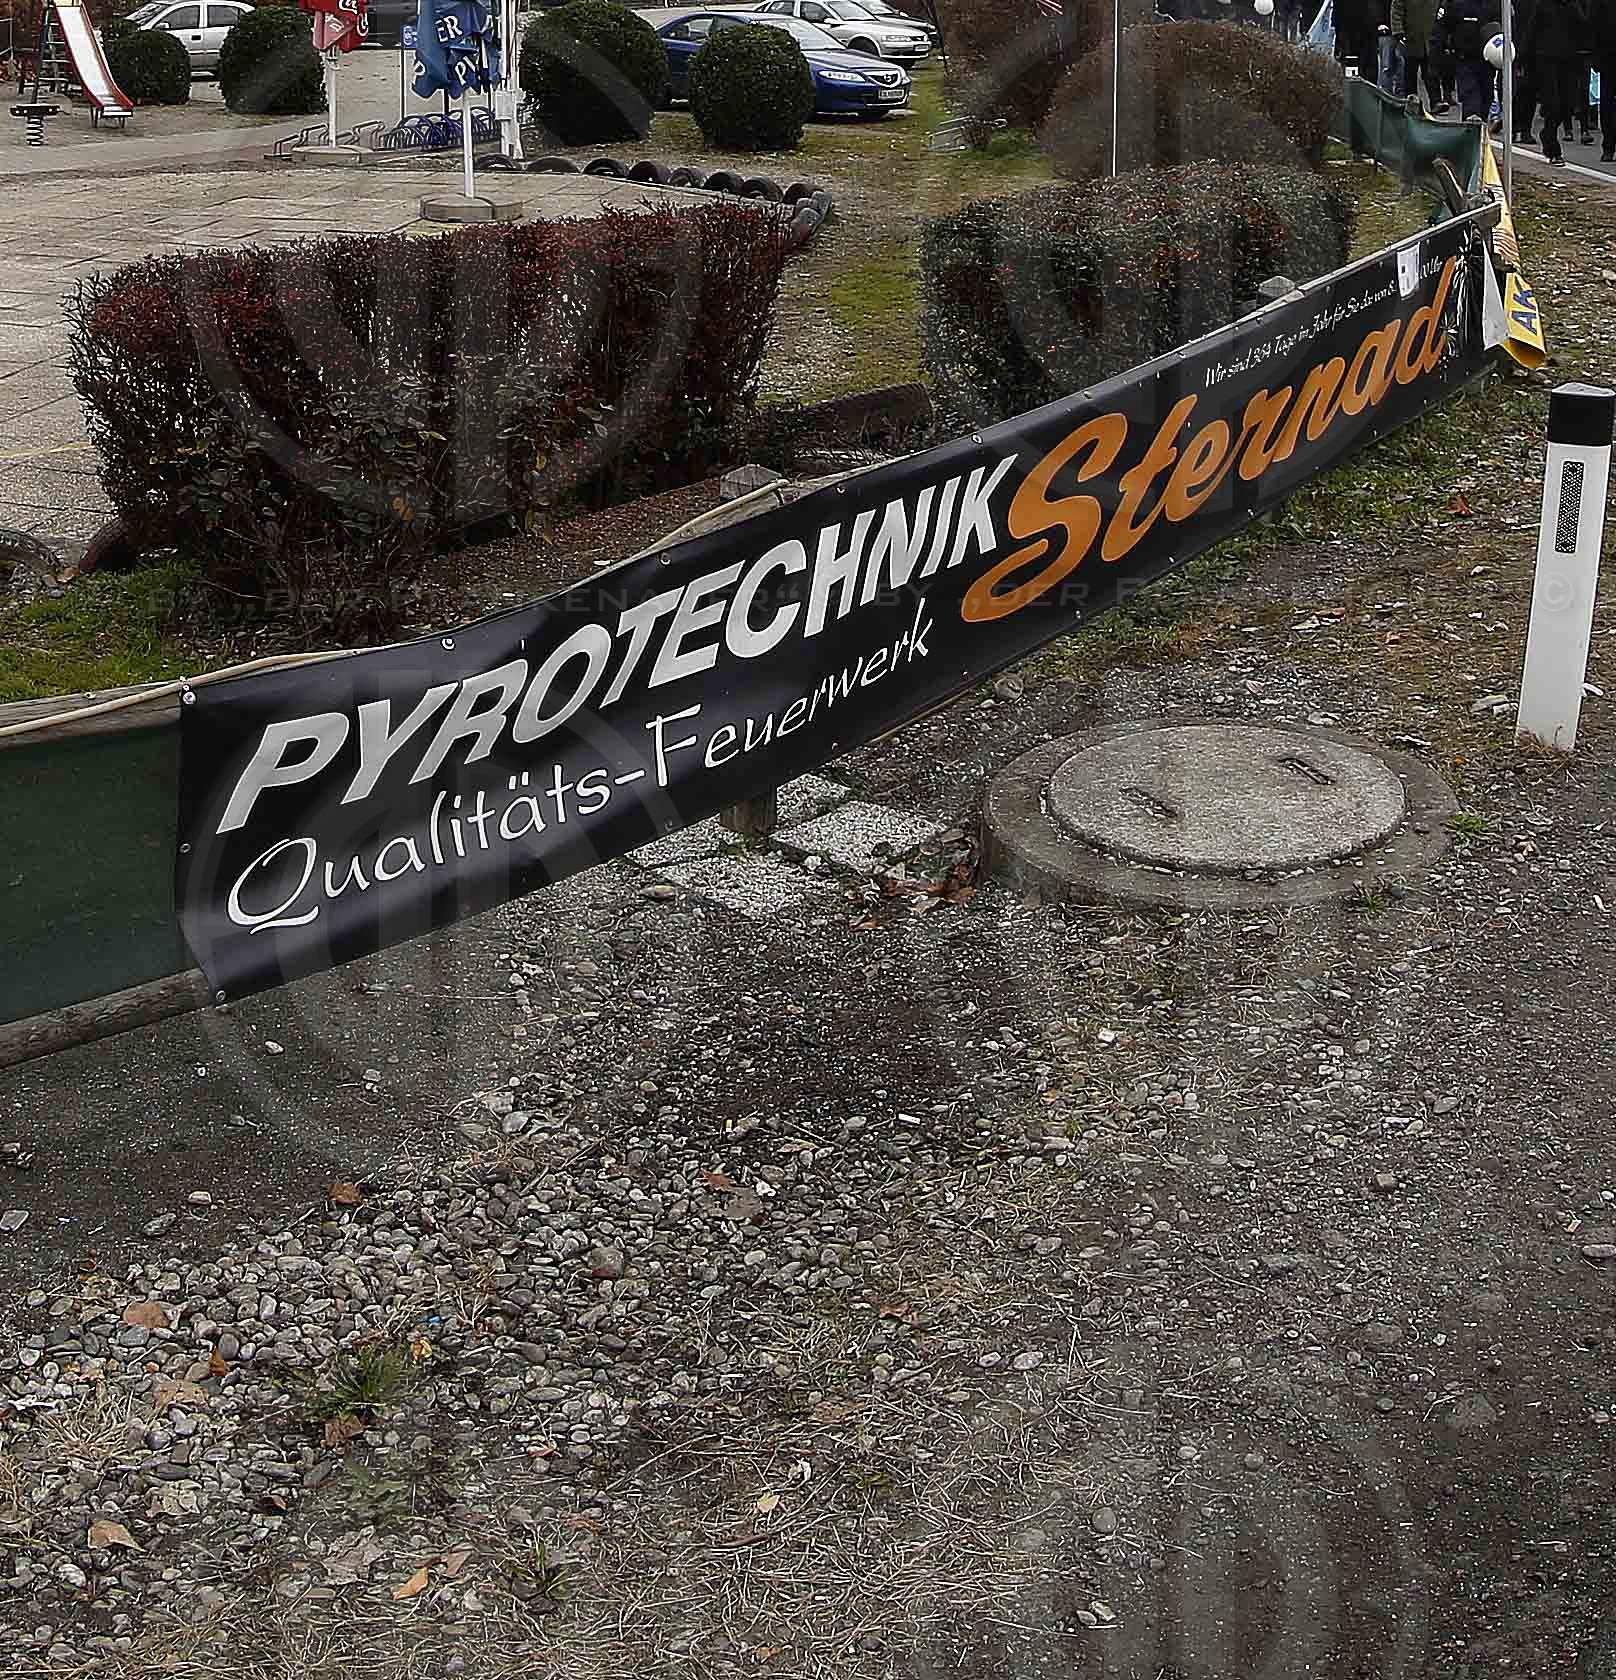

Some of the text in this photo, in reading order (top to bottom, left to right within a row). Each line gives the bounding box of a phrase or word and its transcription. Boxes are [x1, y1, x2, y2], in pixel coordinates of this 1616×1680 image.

[216, 255, 1459, 836] PYROTECHNIK Sternad
[226, 608, 937, 932] Qualitäts-Feuerwerk
